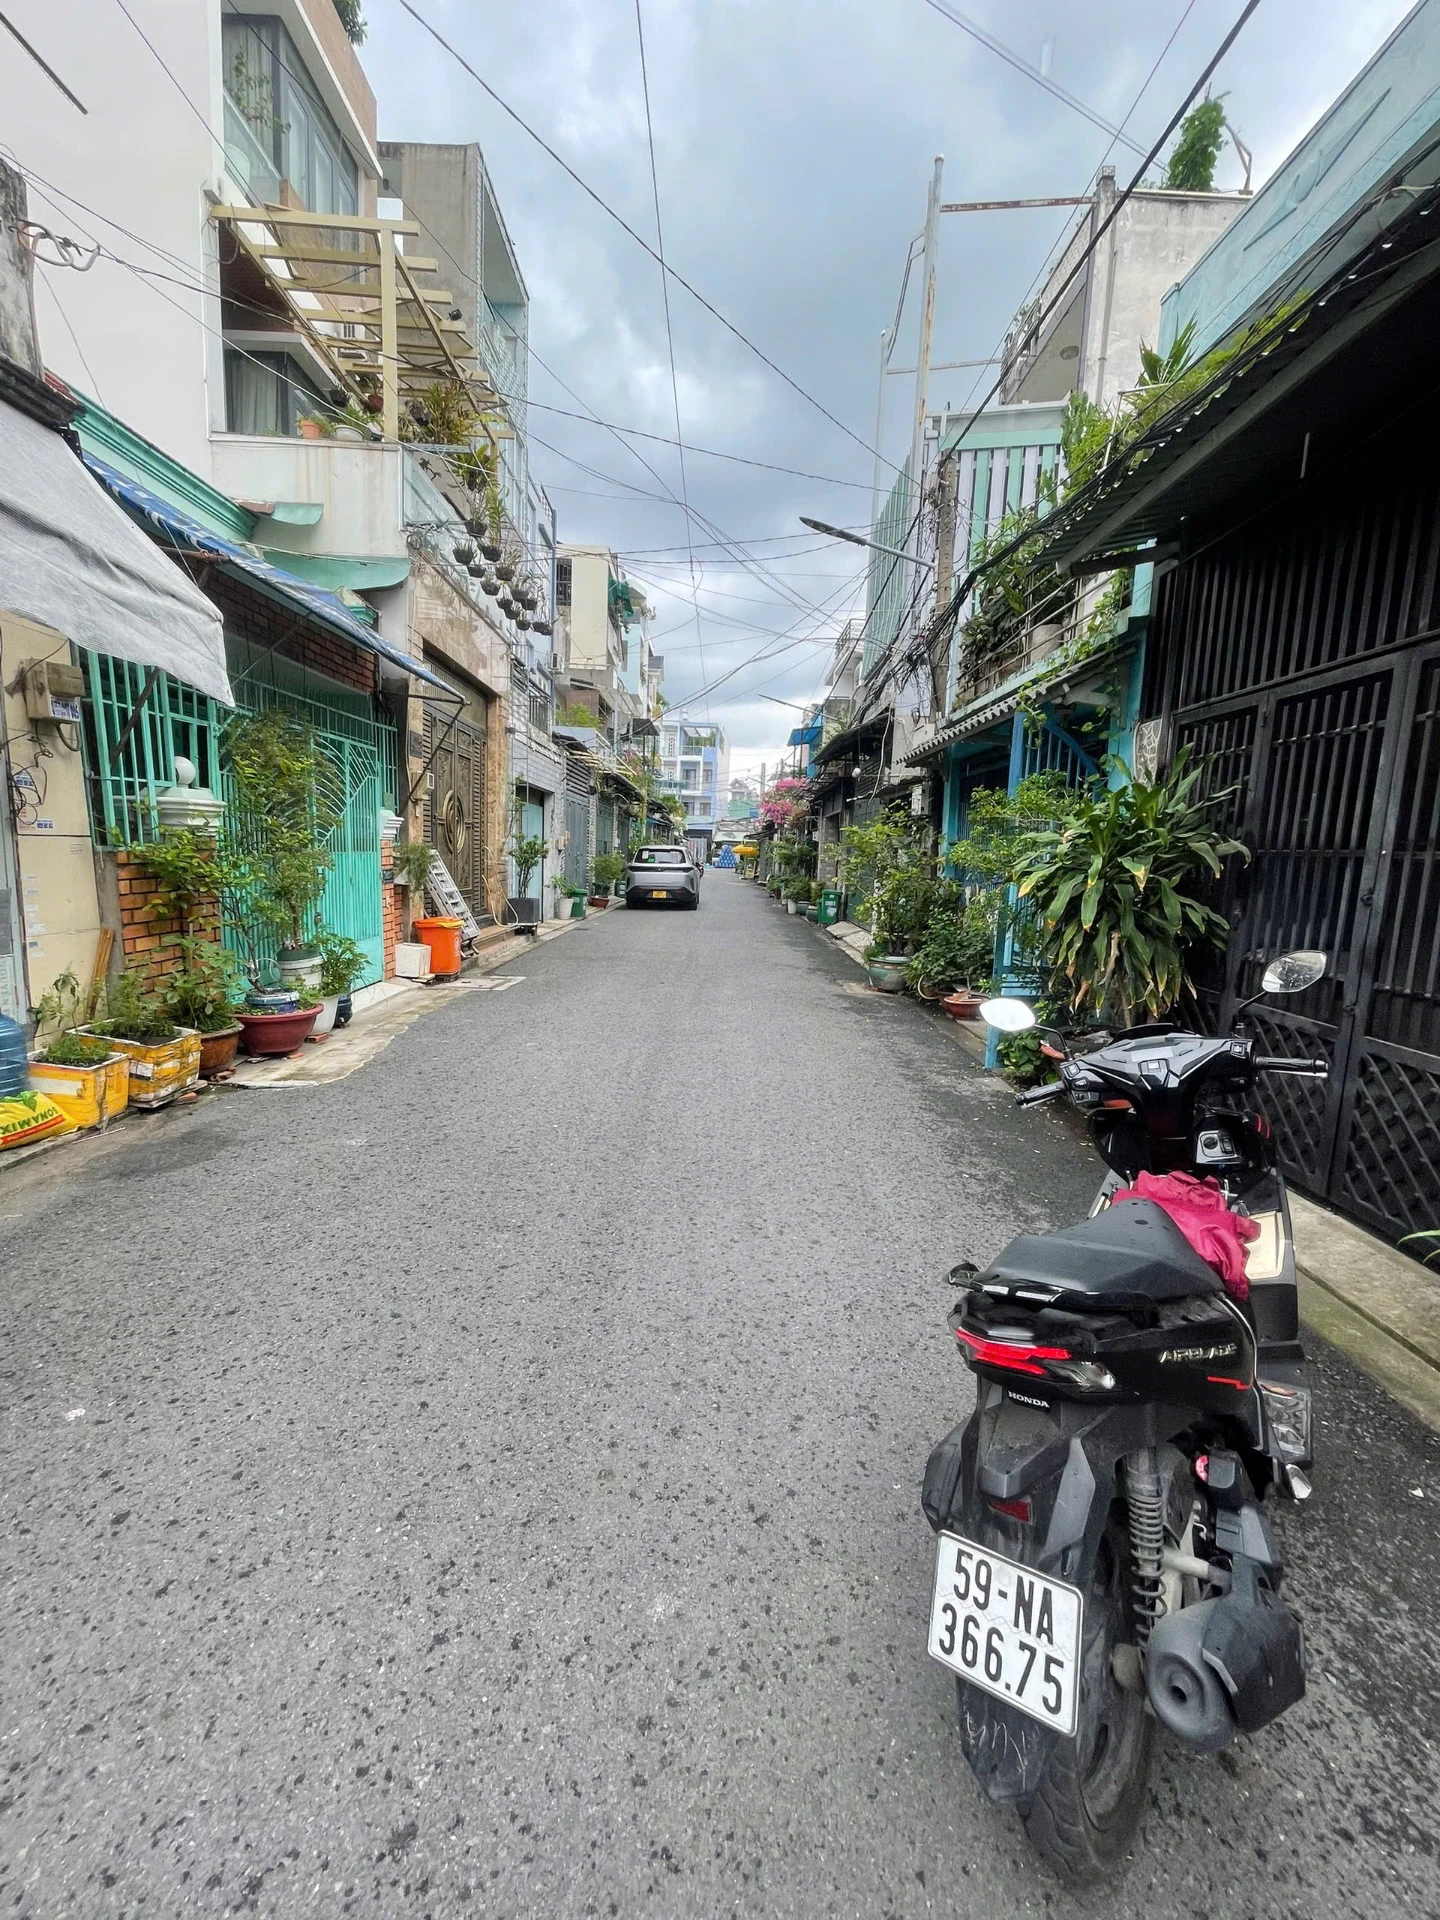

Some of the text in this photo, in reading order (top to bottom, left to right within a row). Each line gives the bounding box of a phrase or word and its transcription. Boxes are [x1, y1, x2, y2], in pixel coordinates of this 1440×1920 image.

[0, 1106, 59, 1135] SONAMIX
[1007, 1390, 1050, 1408] HONDA
[953, 1547, 1054, 1646] 59-NA
[939, 1602, 1065, 1716] 366.75
